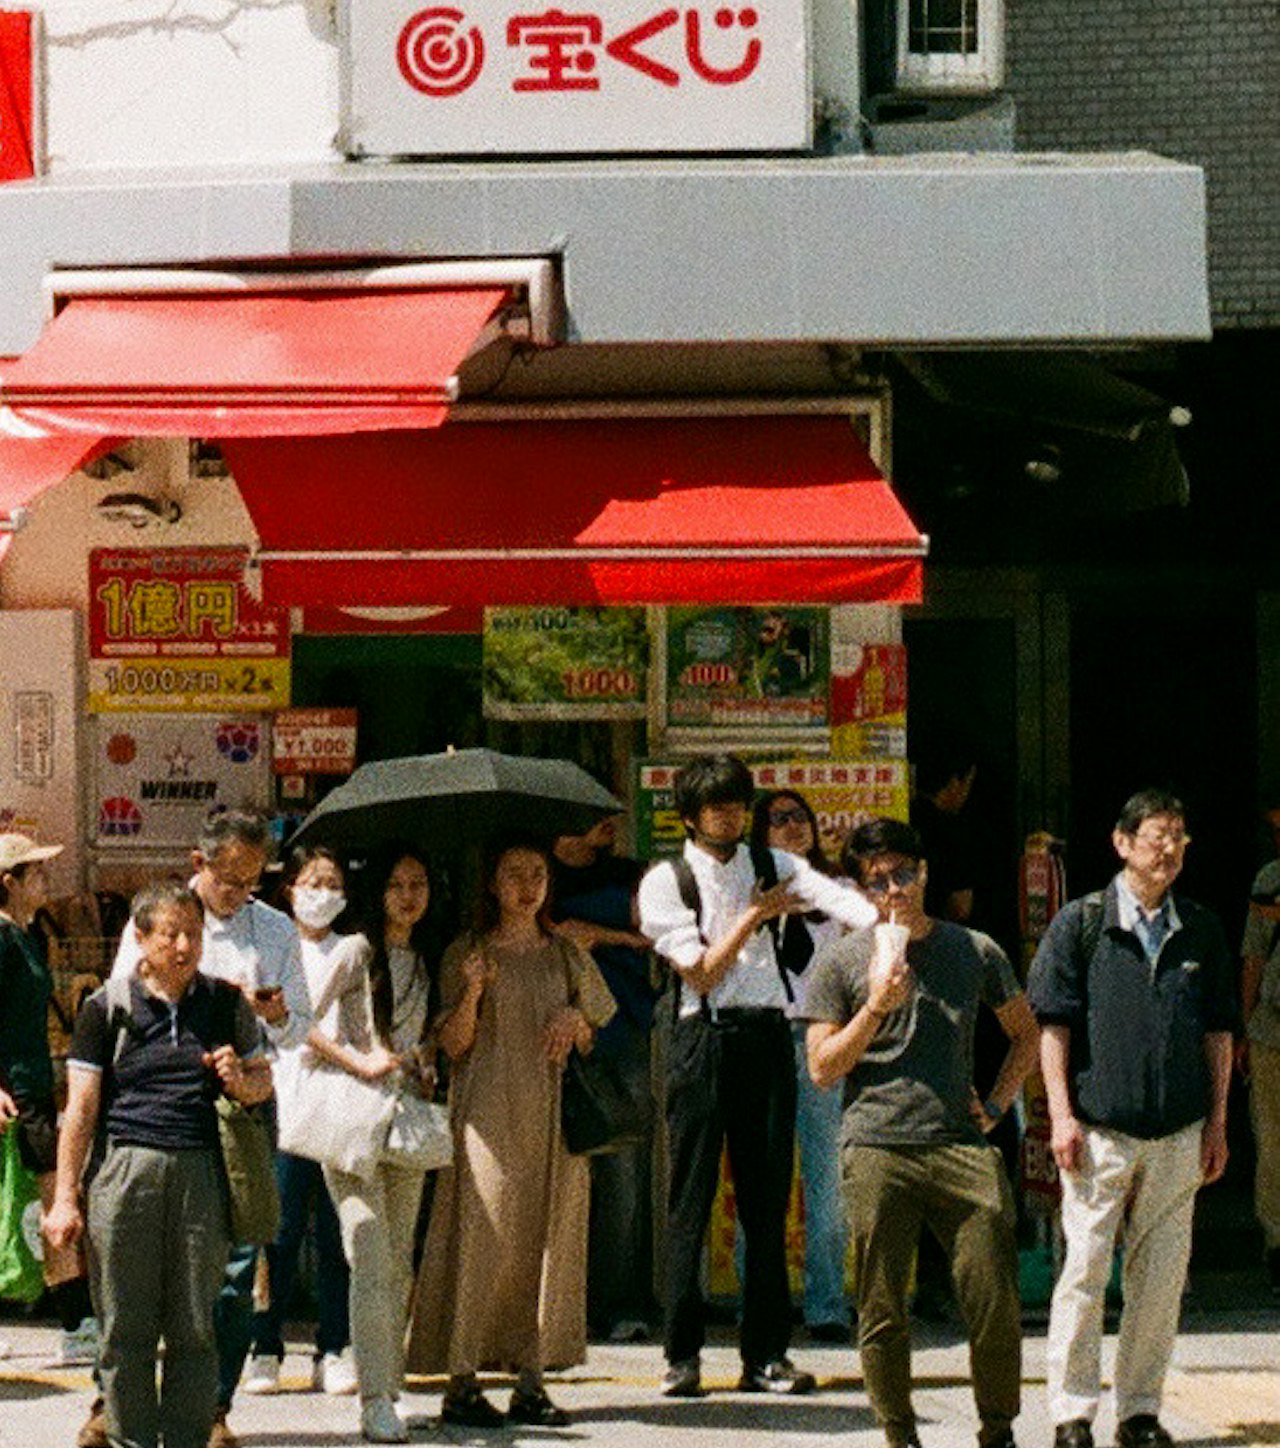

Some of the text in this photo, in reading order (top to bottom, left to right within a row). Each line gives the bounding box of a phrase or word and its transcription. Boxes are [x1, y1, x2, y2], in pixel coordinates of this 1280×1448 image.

[504, 6, 763, 93] 宝くじ
[141, 780, 218, 800] WINNER
